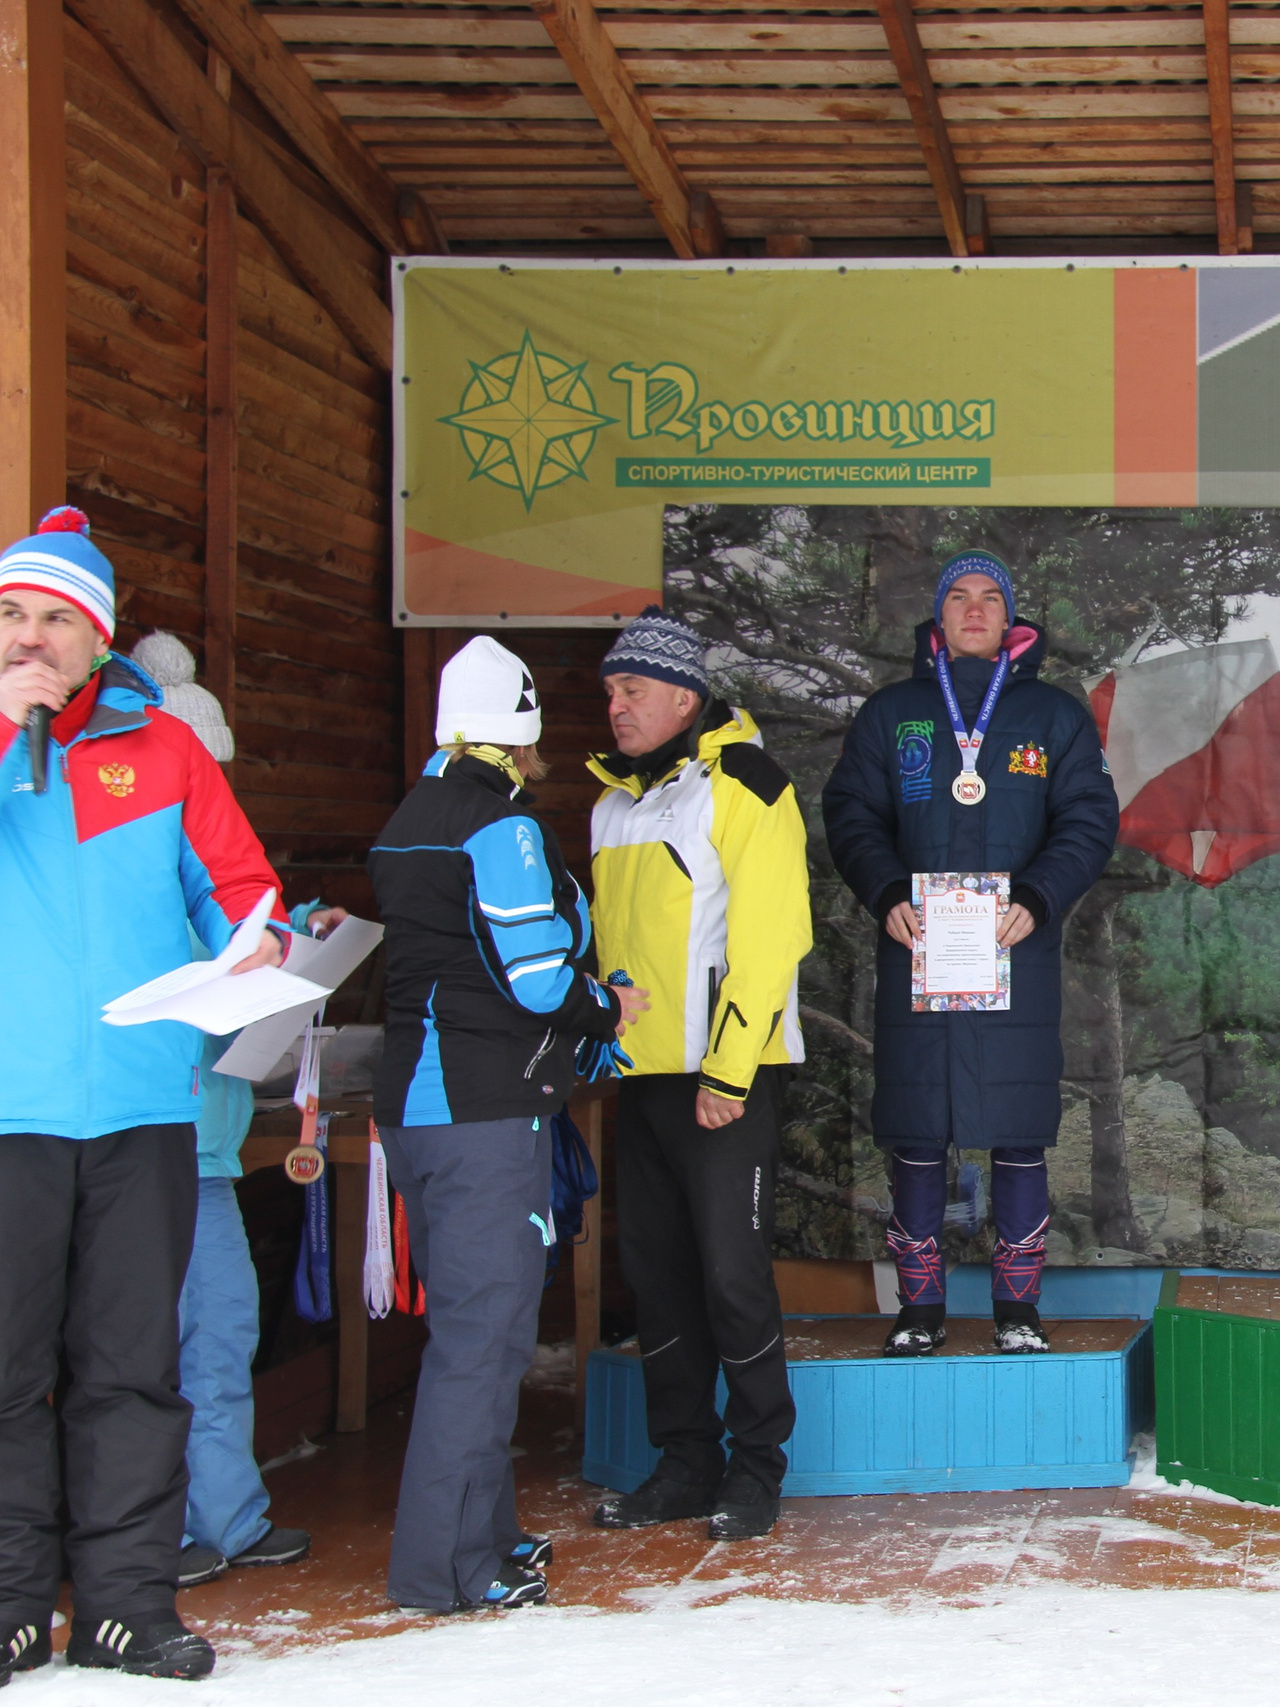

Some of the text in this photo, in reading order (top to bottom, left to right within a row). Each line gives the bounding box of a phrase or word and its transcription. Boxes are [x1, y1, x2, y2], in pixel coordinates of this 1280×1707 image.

[608, 361, 995, 455] Провинция
[628, 463, 979, 484] СПОРТИВНО-ТУРИСТИЧЕСКИЙ ЦЕНТР
[933, 904, 989, 915] ГРАМОТА
[376, 1157, 388, 1249] ЧЕЛЯБИНСКАЯ ОБЛАСТЬ
